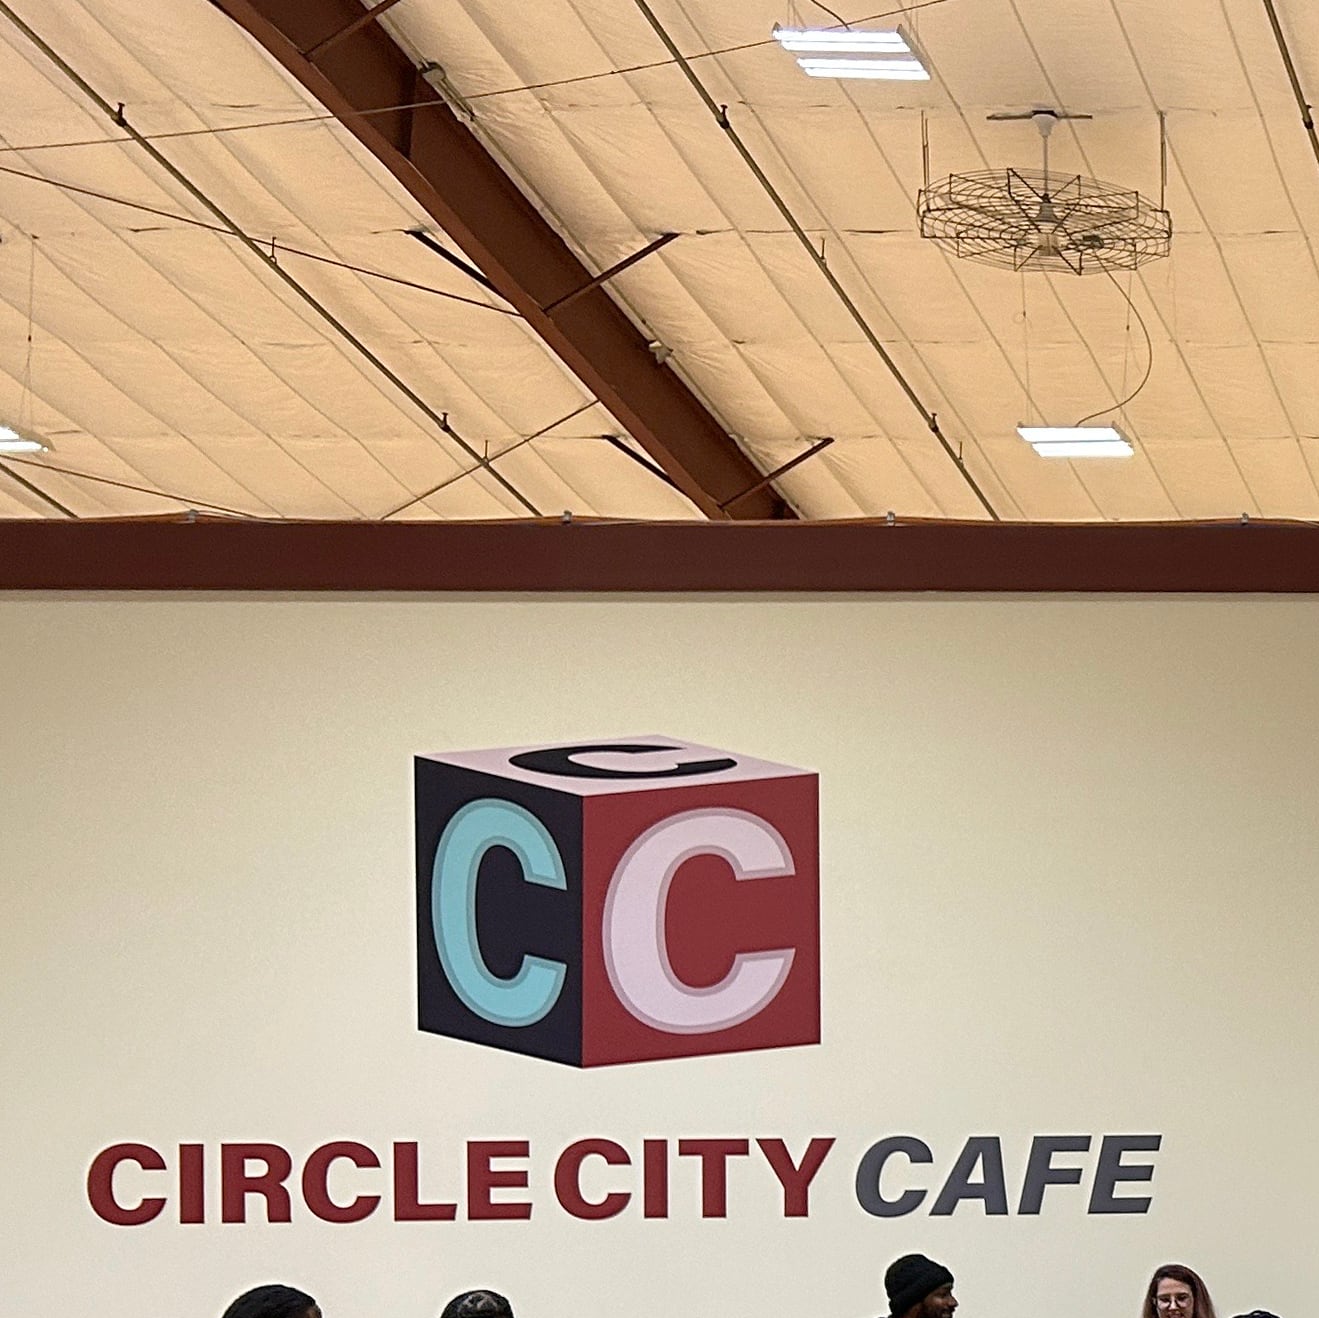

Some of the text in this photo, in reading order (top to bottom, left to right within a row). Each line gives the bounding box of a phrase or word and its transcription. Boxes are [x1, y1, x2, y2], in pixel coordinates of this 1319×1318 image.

[508, 743, 738, 779] C
[431, 797, 568, 1028] C
[602, 806, 796, 1035] C
[86, 1134, 1163, 1227] CIRCLE CITY CAFE
